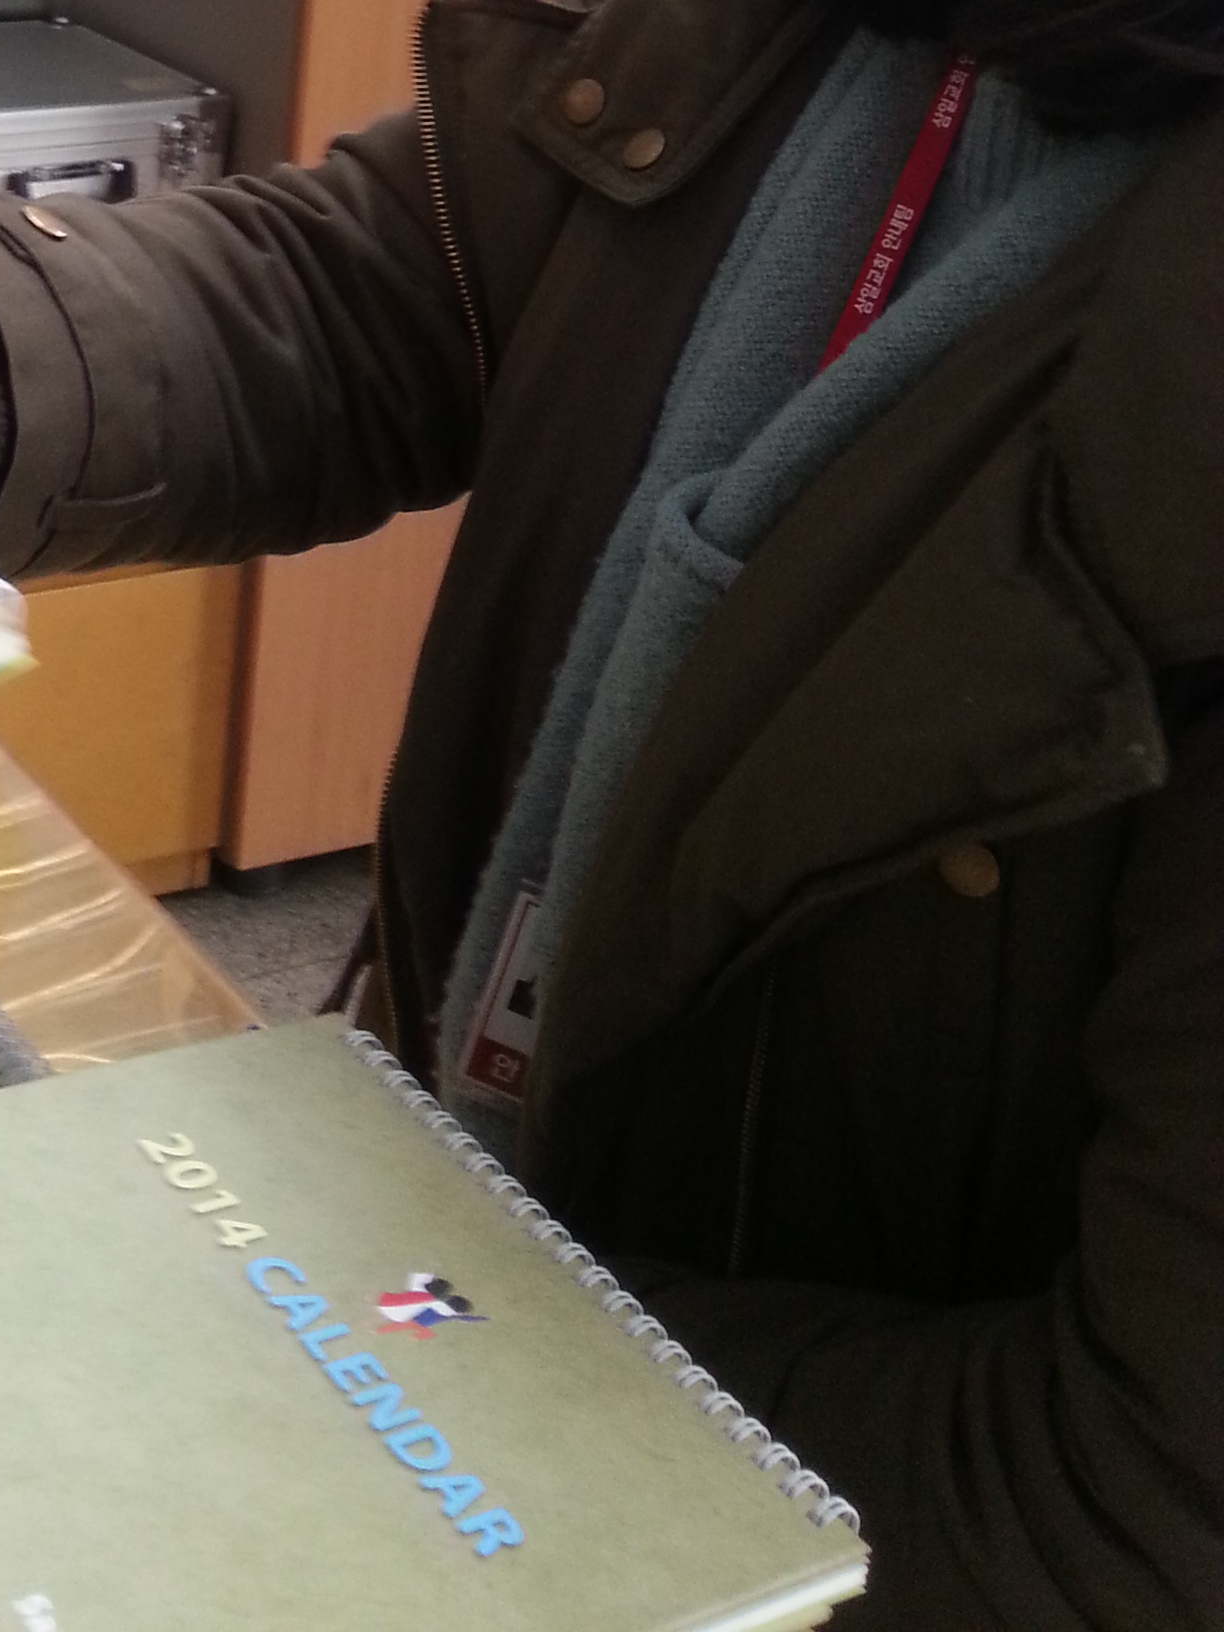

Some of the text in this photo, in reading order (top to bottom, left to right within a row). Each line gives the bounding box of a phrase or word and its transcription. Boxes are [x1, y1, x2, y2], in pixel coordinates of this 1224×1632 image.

[932, 68, 970, 129] 삼일교회
[854, 203, 914, 315] 삼일교회 안내팀
[137, 1131, 526, 1558] 2014 CALENDAR
